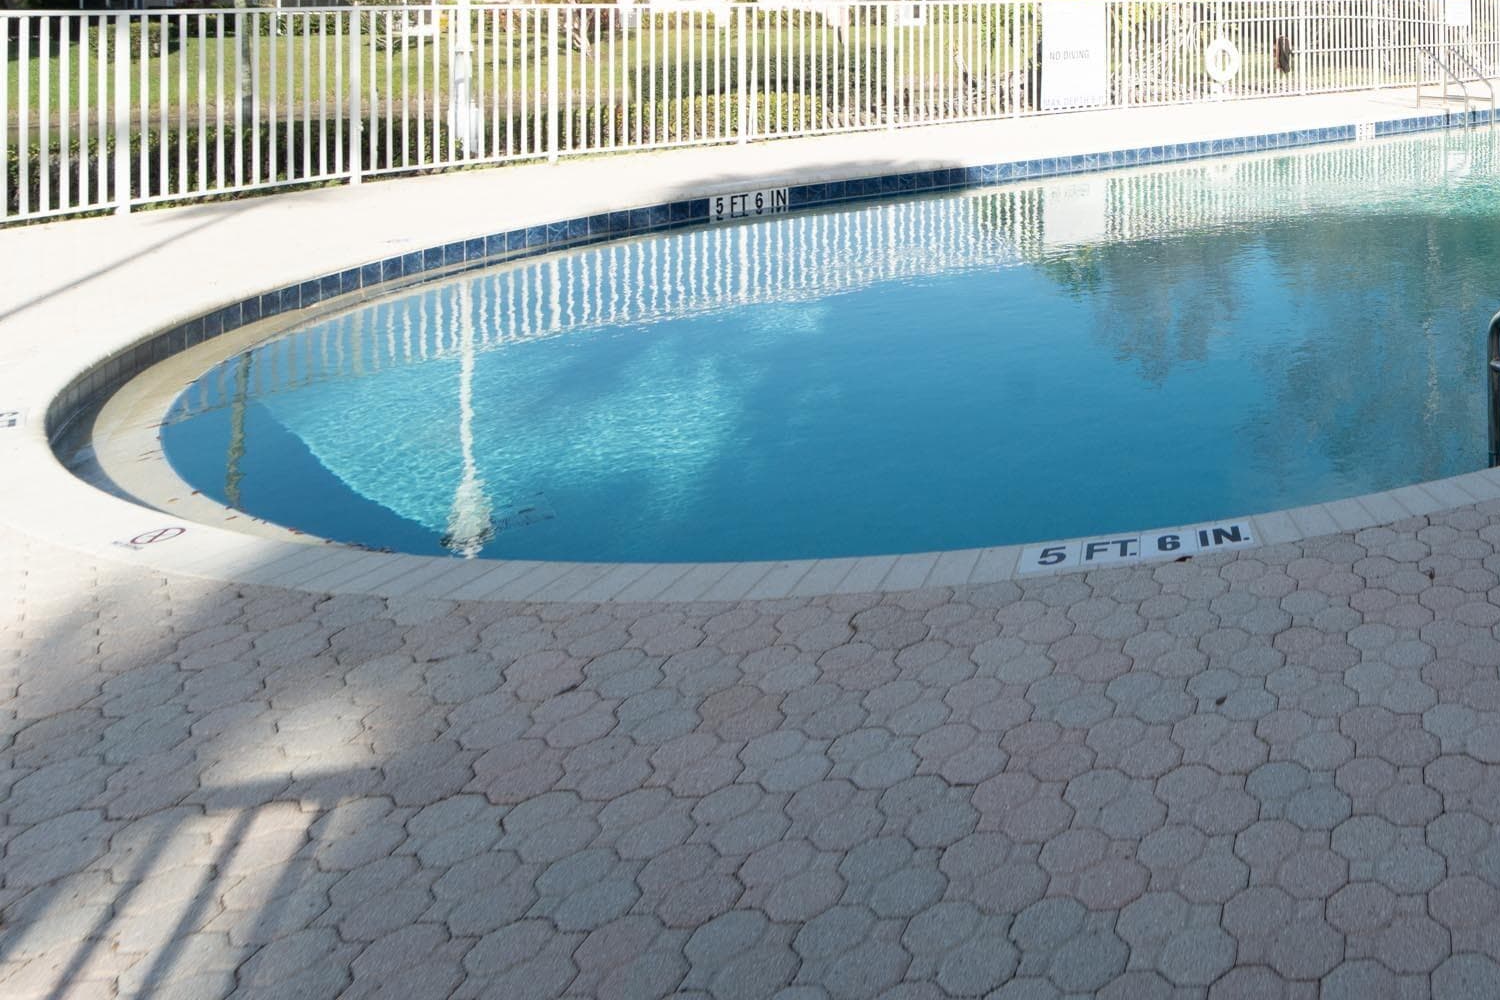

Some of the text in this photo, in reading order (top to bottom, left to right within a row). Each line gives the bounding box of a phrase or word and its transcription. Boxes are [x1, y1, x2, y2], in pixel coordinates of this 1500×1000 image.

[1049, 49, 1090, 61] NO DIVING
[716, 188, 787, 214] 5 FT 6 IN
[1037, 546, 1066, 565] 5
[1157, 534, 1181, 551] 6
